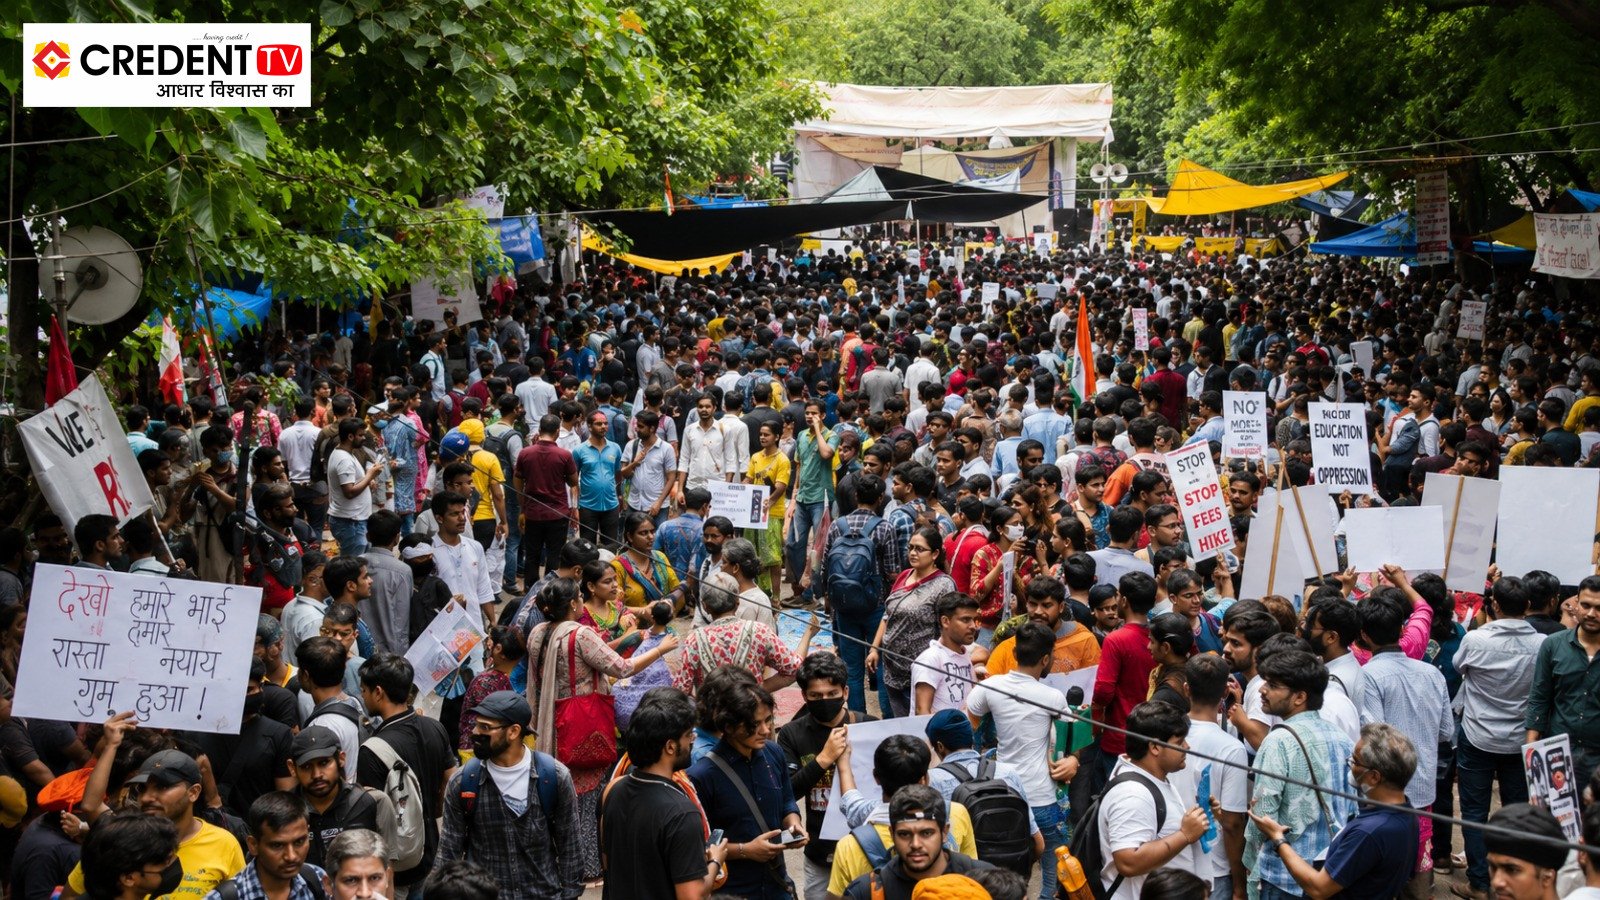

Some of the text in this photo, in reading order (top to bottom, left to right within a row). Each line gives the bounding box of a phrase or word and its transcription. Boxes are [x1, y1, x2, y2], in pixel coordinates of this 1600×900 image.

[45, 411, 94, 458] WE
[1314, 423, 1363, 439] EDUCATION
[1332, 443, 1350, 457] NOT
[1176, 451, 1206, 473] STOP
[1318, 467, 1368, 485] OPPRESSION
[1184, 483, 1219, 507] STOP
[1192, 506, 1223, 529] FEES
[1198, 528, 1230, 553] HIKE
[187, 586, 233, 633] भाई
[52, 638, 110, 669] रास्ता
